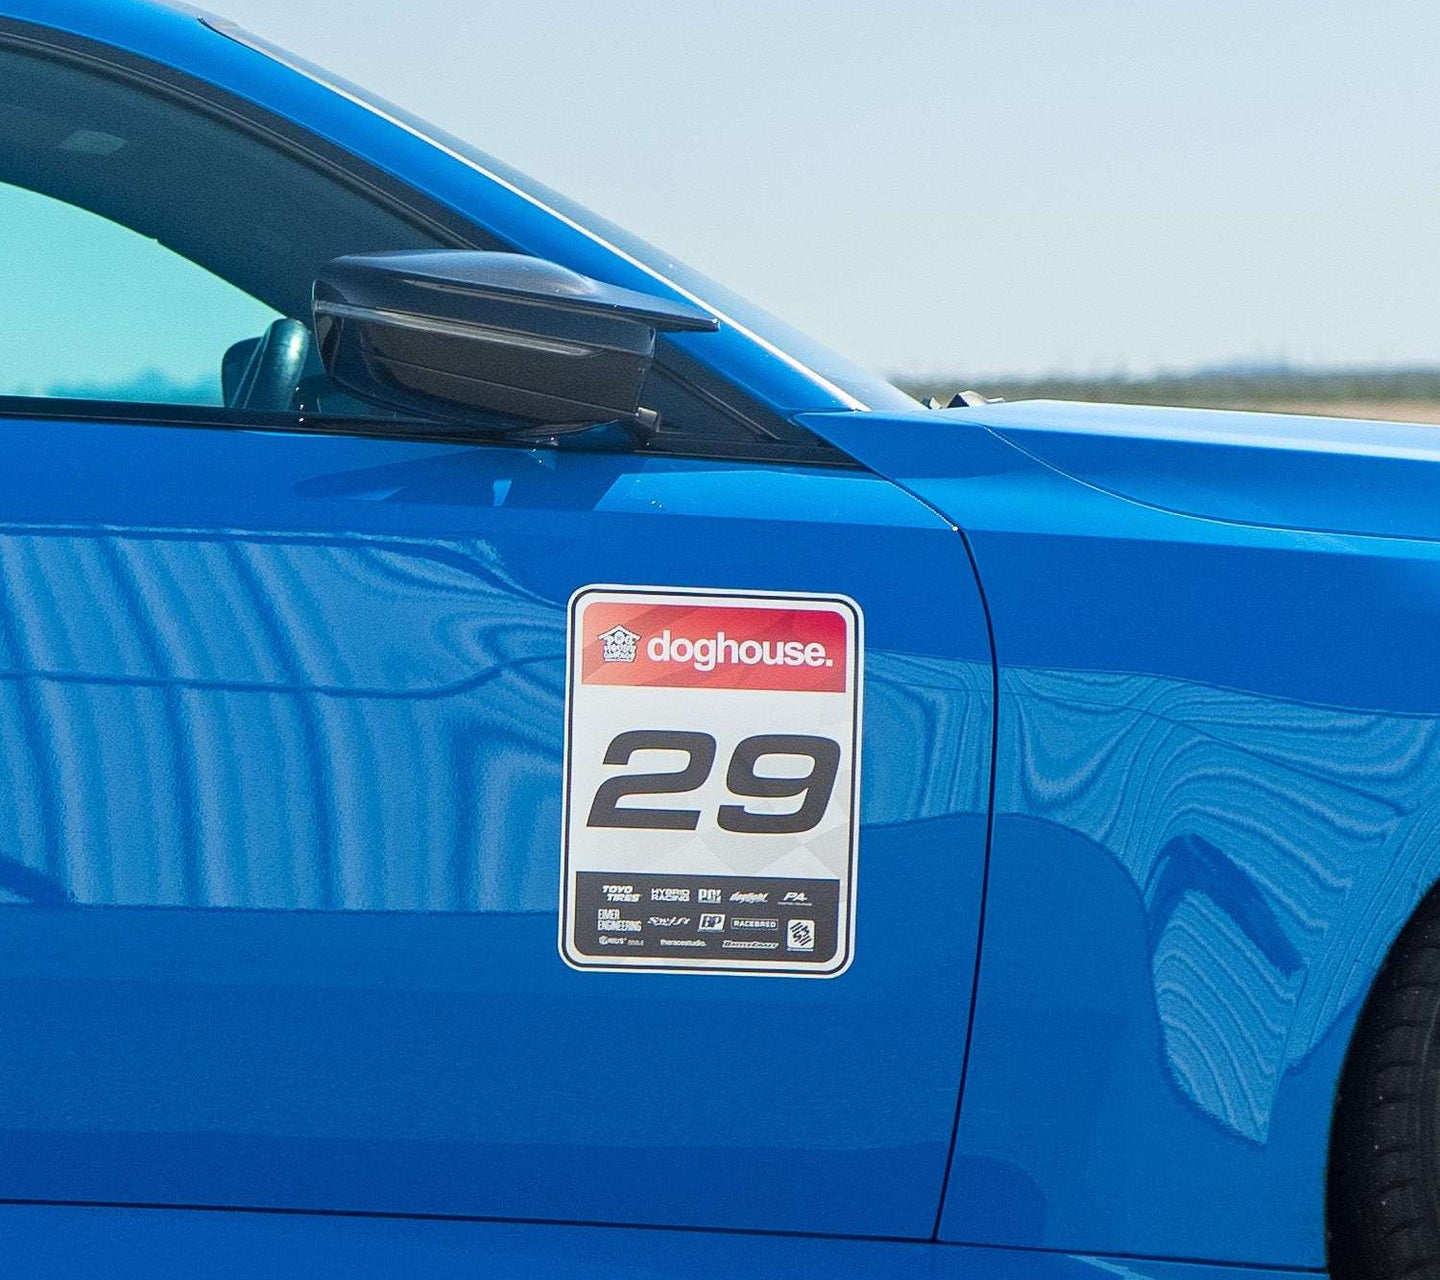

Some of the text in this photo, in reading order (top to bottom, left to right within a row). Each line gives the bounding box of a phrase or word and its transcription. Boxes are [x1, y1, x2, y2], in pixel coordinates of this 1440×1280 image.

[646, 629, 833, 671] doghouse.
[586, 729, 841, 833] 29
[602, 885, 634, 894] TOYO
[606, 893, 642, 903] TIRES
